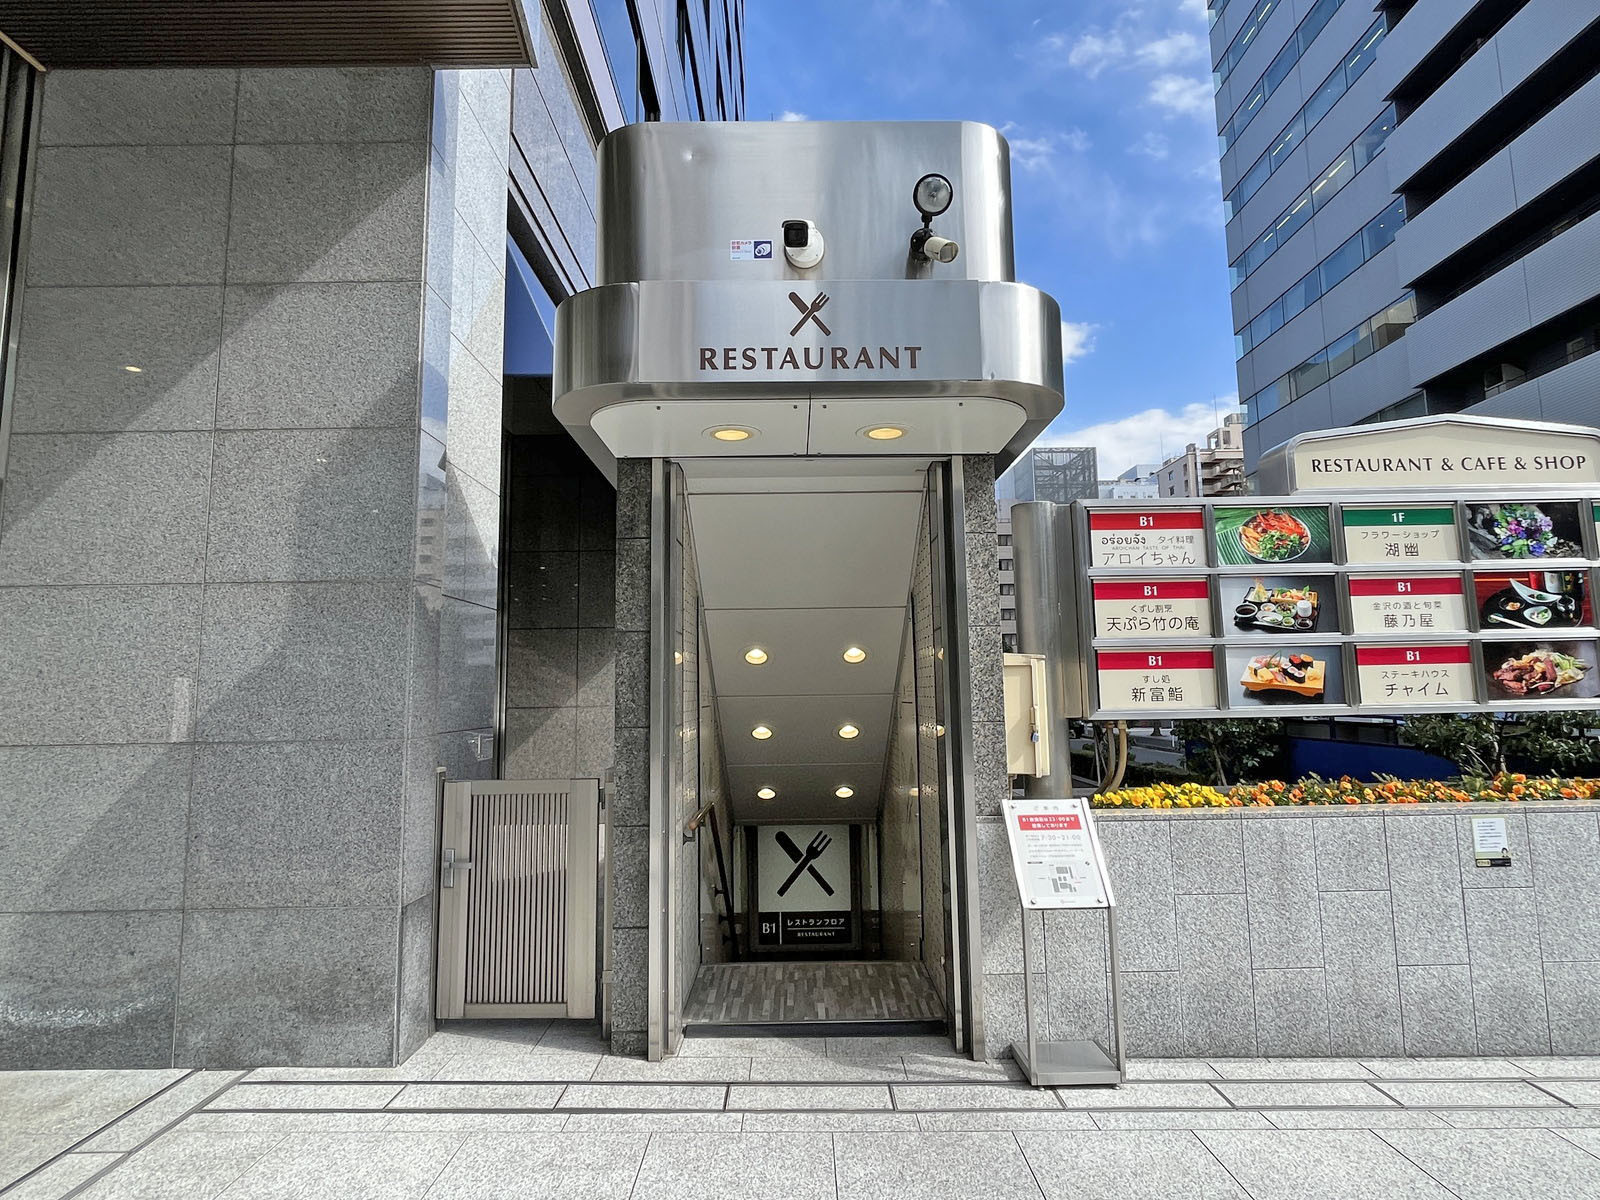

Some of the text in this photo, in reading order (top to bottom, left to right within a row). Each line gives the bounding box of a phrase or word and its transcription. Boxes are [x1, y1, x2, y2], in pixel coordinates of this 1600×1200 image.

[700, 346, 922, 370] RESTAURANT
[1312, 455, 1587, 472] RESTAURANT & CAFE & SHOP
[1139, 516, 1154, 527] B1
[1391, 513, 1405, 522] 1F
[1101, 533, 1146, 545] อร่อยจัง
[1157, 535, 1194, 545] タイ料理
[1361, 529, 1440, 540] フラワーショップ
[1102, 551, 1196, 566] アロイちゃん
[1143, 585, 1158, 596] B1
[1397, 581, 1412, 592] B1
[1130, 604, 1173, 613] くずし割烹
[1372, 601, 1442, 611] 金沢の酒と旬菜
[1106, 616, 1200, 632] 天ぷら竹の庵
[1383, 614, 1435, 628] 藤乃屋
[1148, 655, 1163, 666] B1
[1406, 650, 1421, 661] B1
[1142, 674, 1171, 683] すし処
[1381, 669, 1450, 680] ステーキハウス
[1131, 687, 1184, 702] 新富鮨
[1385, 683, 1449, 697] チャイム
[787, 918, 845, 926] レストランフロア
[762, 922, 776, 934] B1
